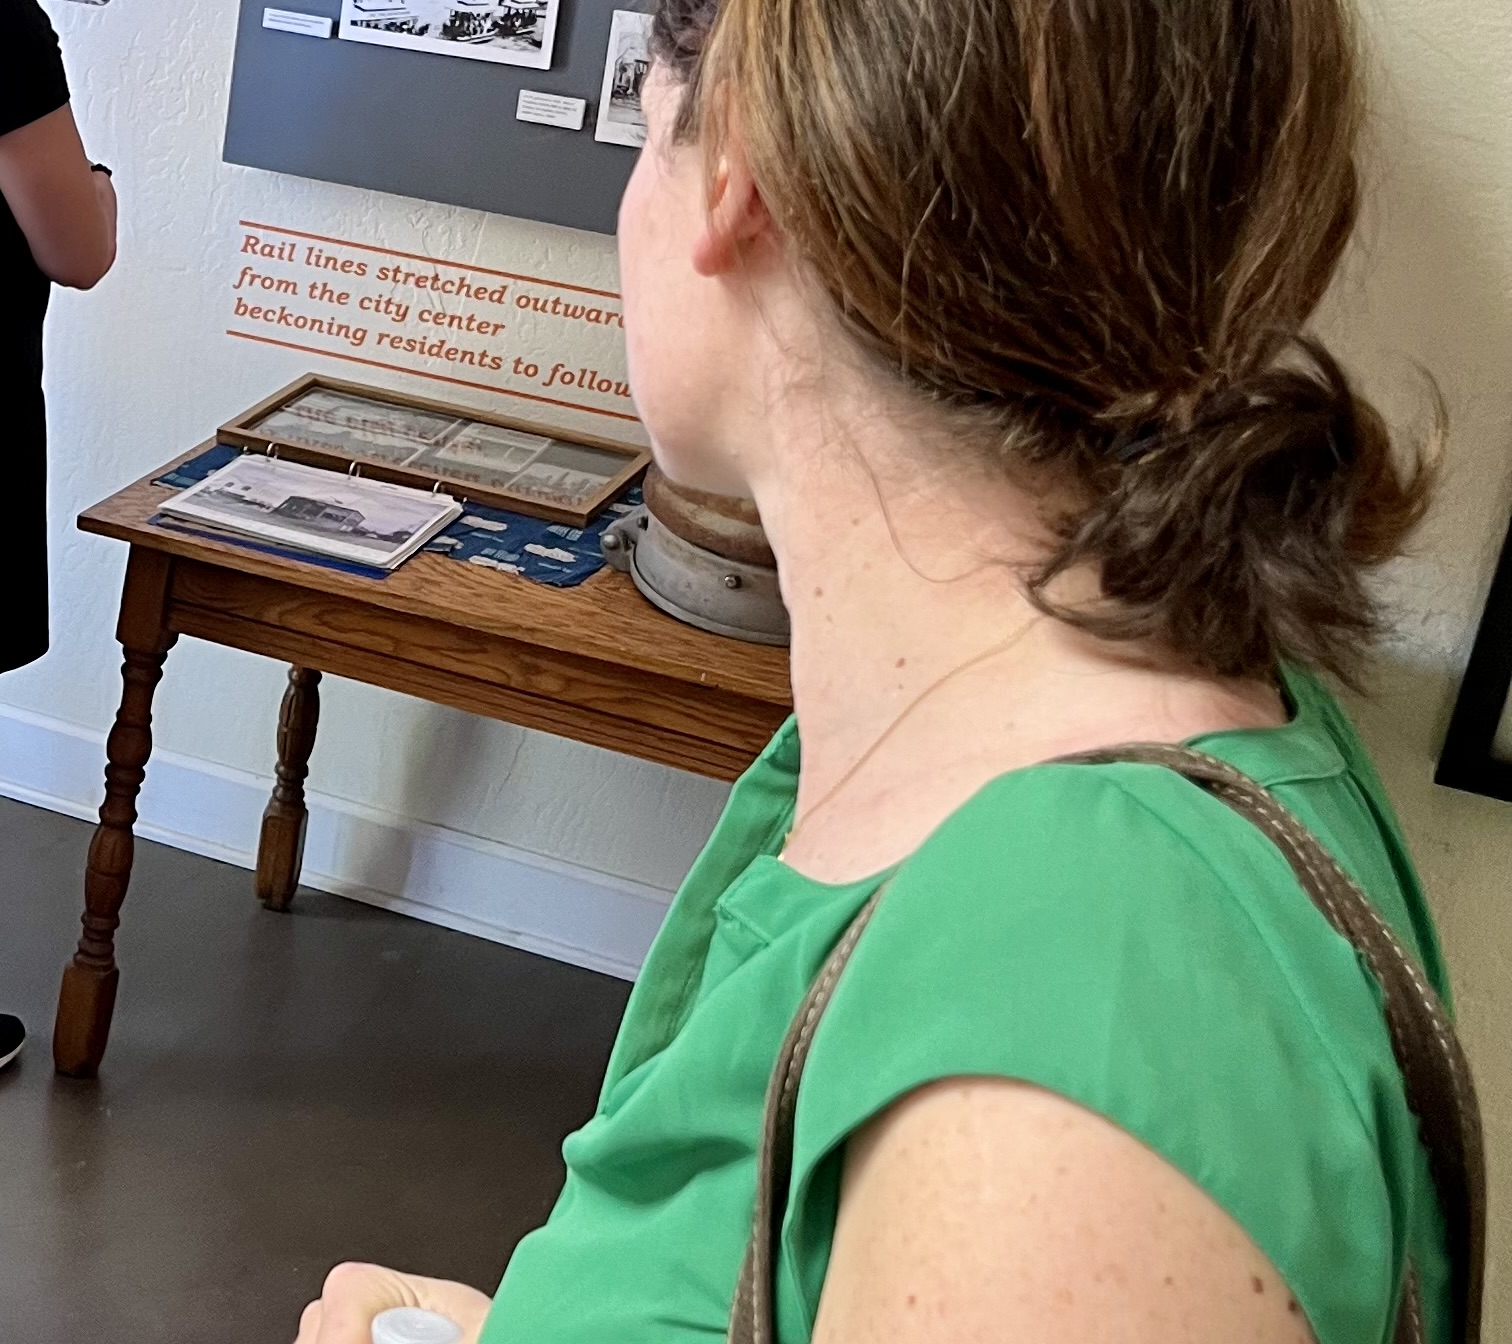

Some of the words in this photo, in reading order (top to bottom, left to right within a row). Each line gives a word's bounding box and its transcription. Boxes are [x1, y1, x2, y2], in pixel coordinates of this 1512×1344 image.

[232, 266, 298, 296] from
[308, 282, 350, 305] the
[359, 294, 410, 323] city
[418, 307, 506, 337] center
[240, 235, 297, 262] Rail
[304, 247, 368, 276] lines
[376, 265, 508, 305] stretched
[234, 297, 368, 347] beckoning
[376, 332, 503, 370] residents
[513, 357, 539, 378] to
